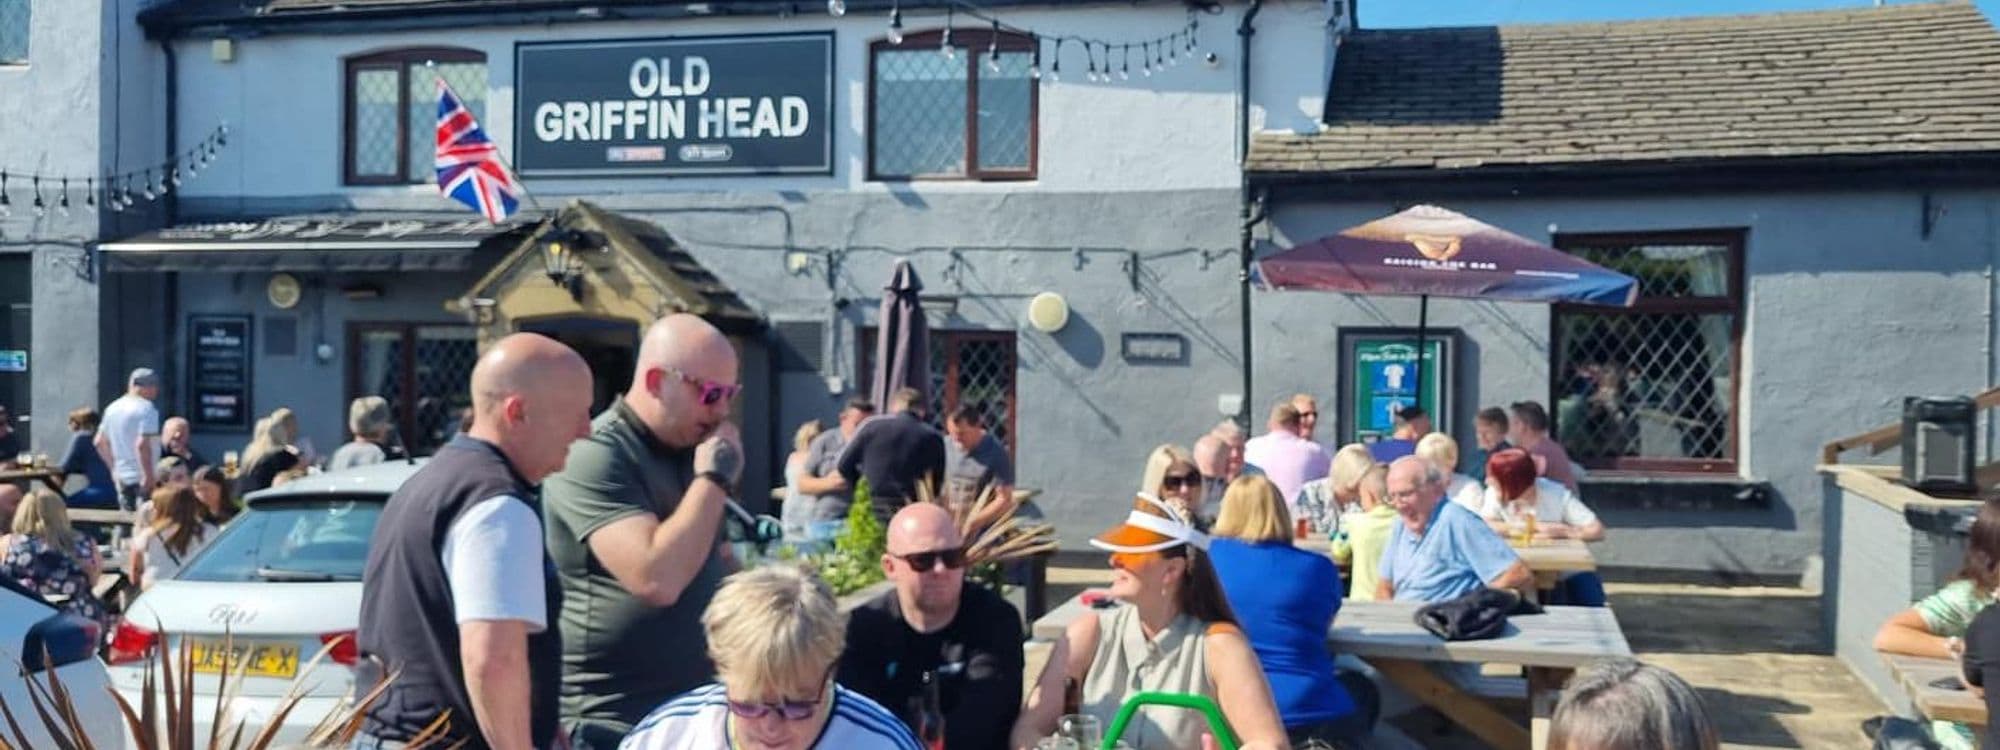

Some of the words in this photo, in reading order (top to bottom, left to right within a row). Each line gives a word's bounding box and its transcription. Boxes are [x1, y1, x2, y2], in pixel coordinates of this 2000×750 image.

[629, 56, 711, 98] OLD
[534, 99, 686, 142] GRIFFIN
[697, 96, 810, 139] HEAD
